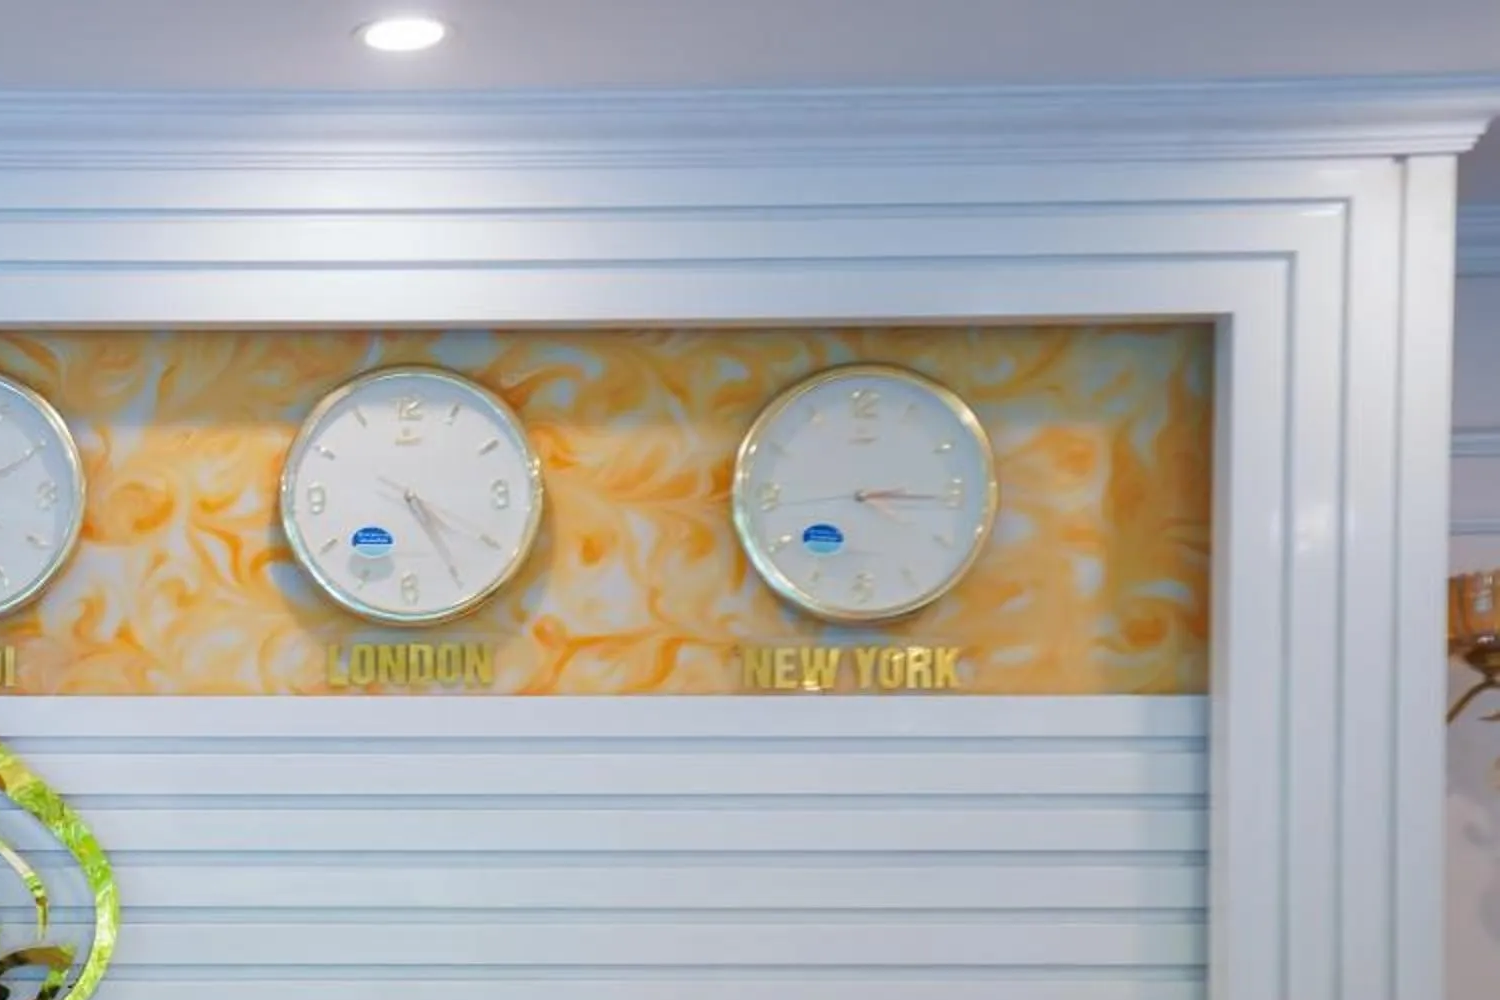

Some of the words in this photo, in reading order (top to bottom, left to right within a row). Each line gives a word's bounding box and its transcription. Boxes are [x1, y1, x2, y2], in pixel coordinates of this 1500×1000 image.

[396, 396, 424, 420] 12
[492, 479, 509, 509] 3
[401, 573, 419, 605] 6
[328, 644, 495, 688] LONDON
[743, 648, 841, 690] NEW
[855, 646, 961, 689] YORK
